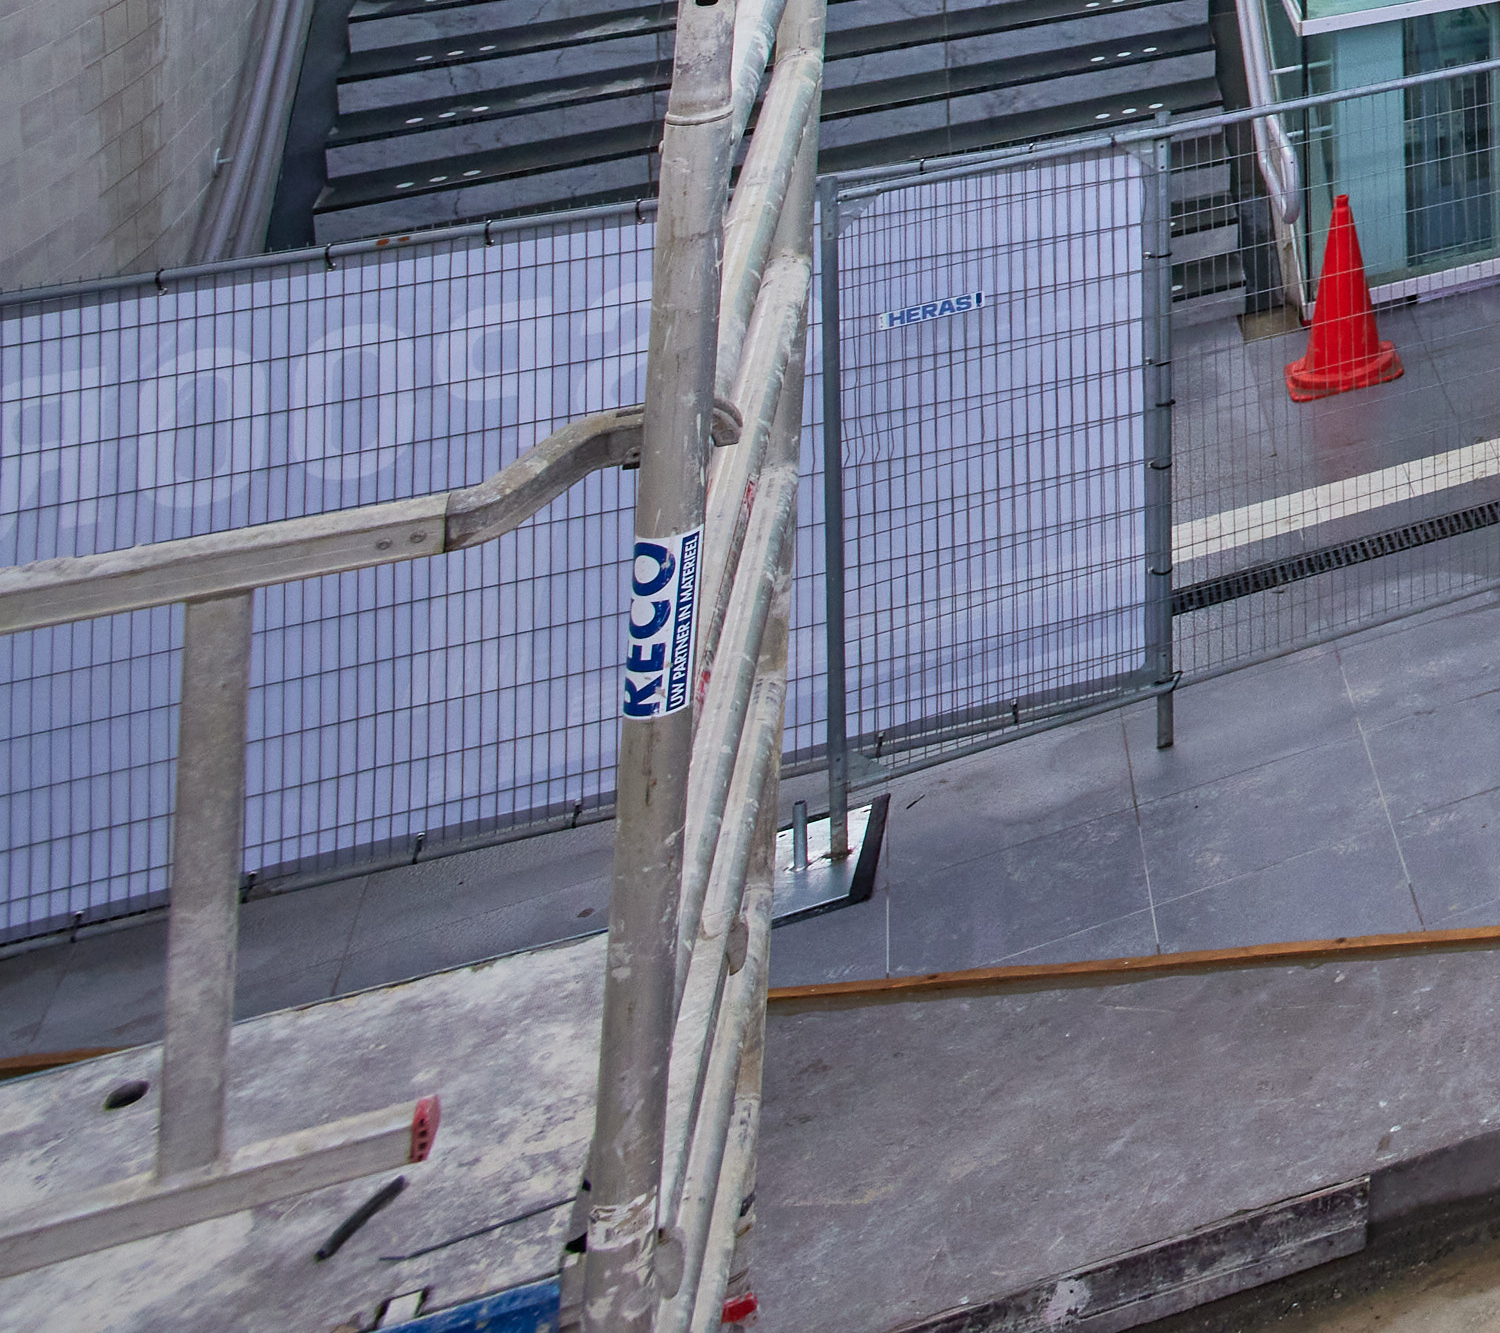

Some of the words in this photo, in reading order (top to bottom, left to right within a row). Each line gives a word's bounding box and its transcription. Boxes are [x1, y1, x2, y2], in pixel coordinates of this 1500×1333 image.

[680, 535, 698, 607] MATERIEEL
[623, 542, 676, 717] RECO
[678, 608, 692, 623] IN
[674, 624, 690, 683] PARTNER
[671, 686, 686, 708] UW
